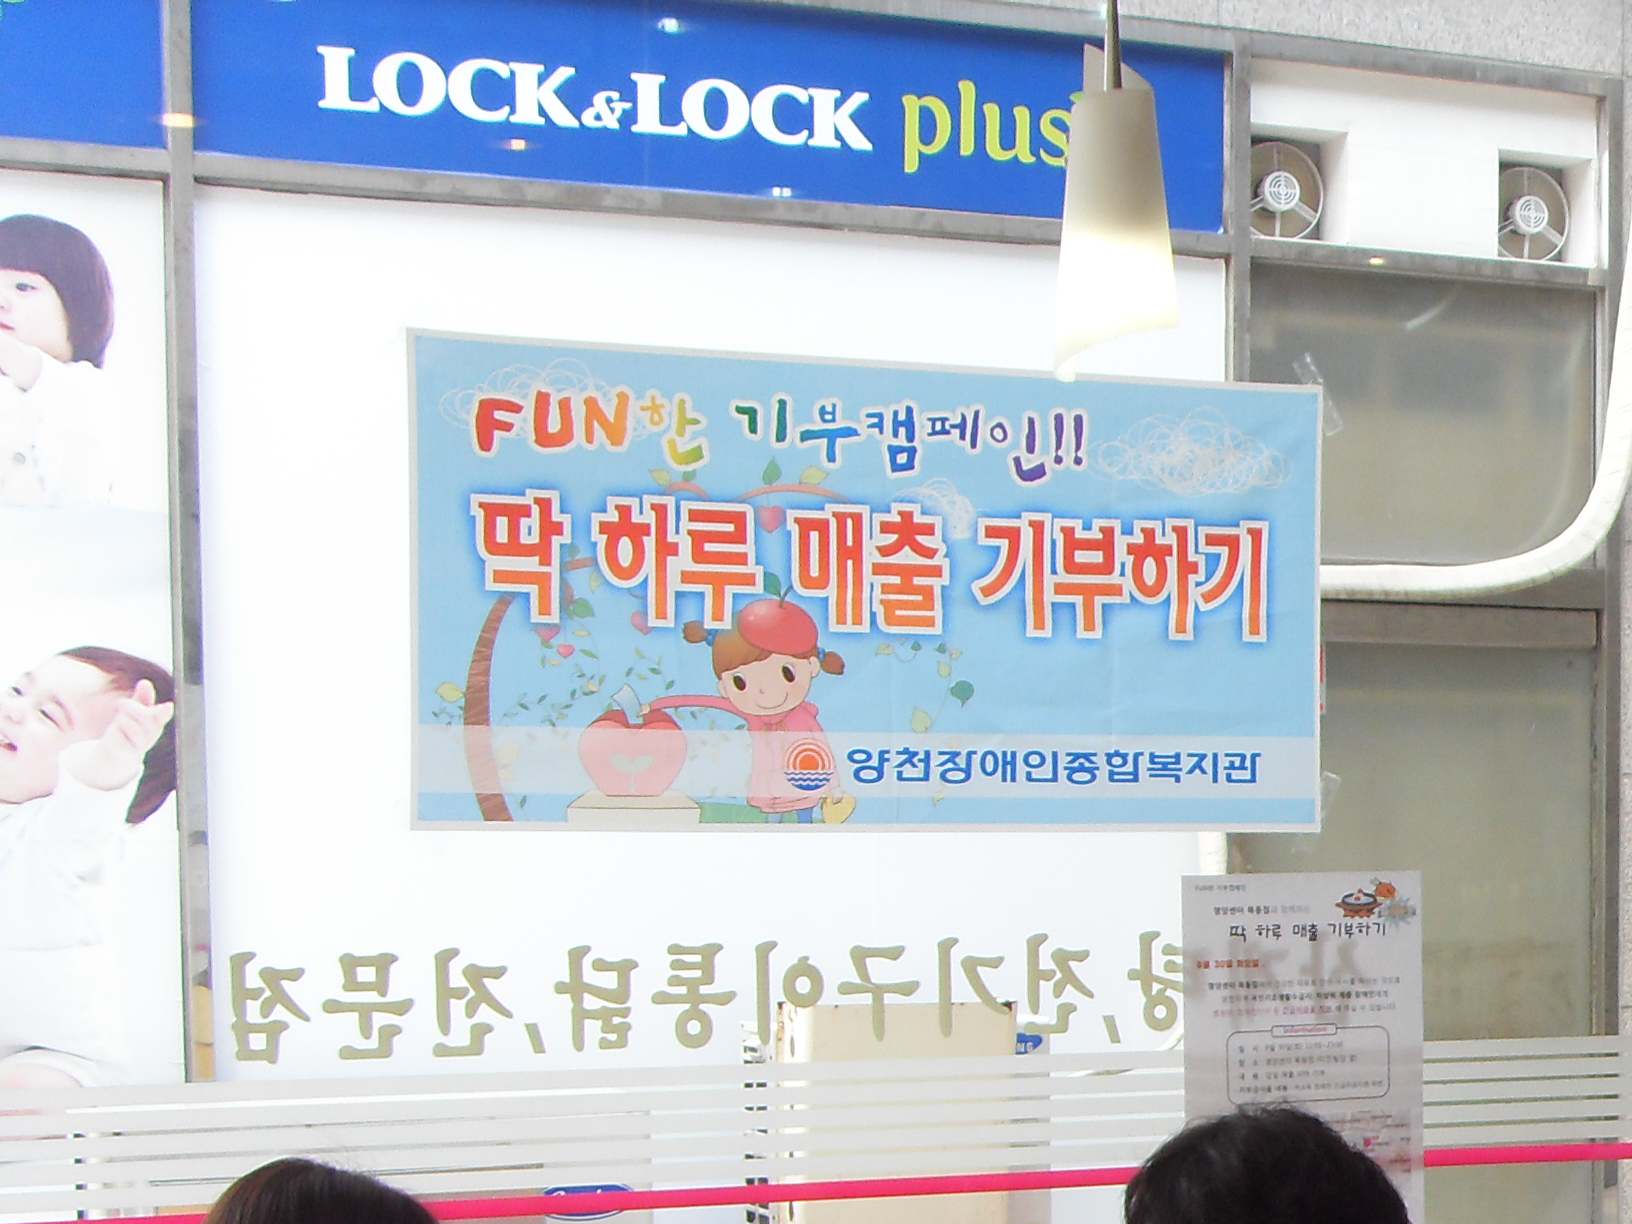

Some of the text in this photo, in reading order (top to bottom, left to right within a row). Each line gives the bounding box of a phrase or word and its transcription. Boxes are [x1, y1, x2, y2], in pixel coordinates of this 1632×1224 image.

[317, 45, 1071, 173] LOCK&LOCK plus
[474, 388, 1086, 483] FUN한 기부캠페인!!
[474, 491, 1270, 642] 딱 하루 매출 기부하기
[846, 746, 1261, 785] 양천장애인종합복지관
[1228, 920, 1387, 943] 딱 하루 매출 기부하기
